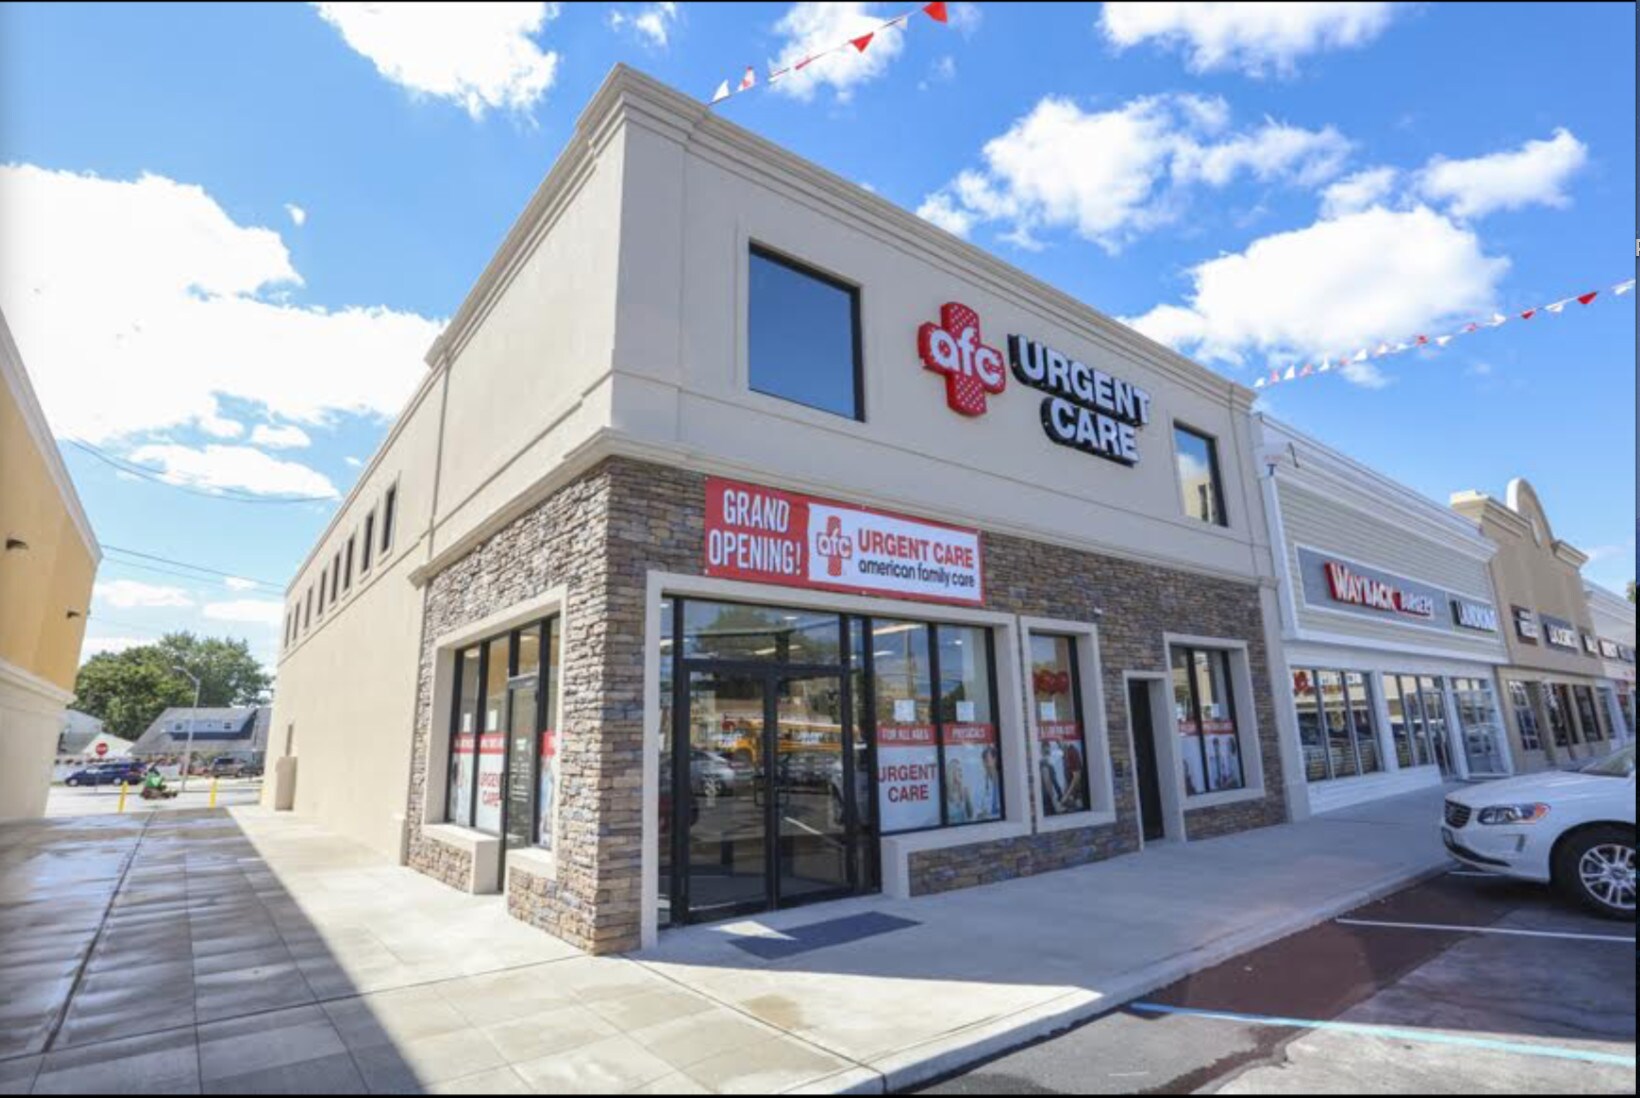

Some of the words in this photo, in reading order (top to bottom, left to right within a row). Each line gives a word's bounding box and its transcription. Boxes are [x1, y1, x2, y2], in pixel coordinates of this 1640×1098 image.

[930, 327, 999, 386] afc
[1016, 334, 1150, 425] URGENT
[1050, 397, 1140, 462] CARE
[723, 489, 790, 533] GRAND
[708, 529, 801, 575] OPENING!
[817, 528, 852, 558] afc
[858, 528, 930, 562] URGENT
[933, 542, 974, 569] CARE
[859, 558, 916, 580] american
[917, 562, 951, 588] family
[952, 570, 975, 588] care
[1327, 561, 1397, 611] WAYBACK
[878, 763, 937, 783] URGENT
[888, 784, 929, 803] CARE
